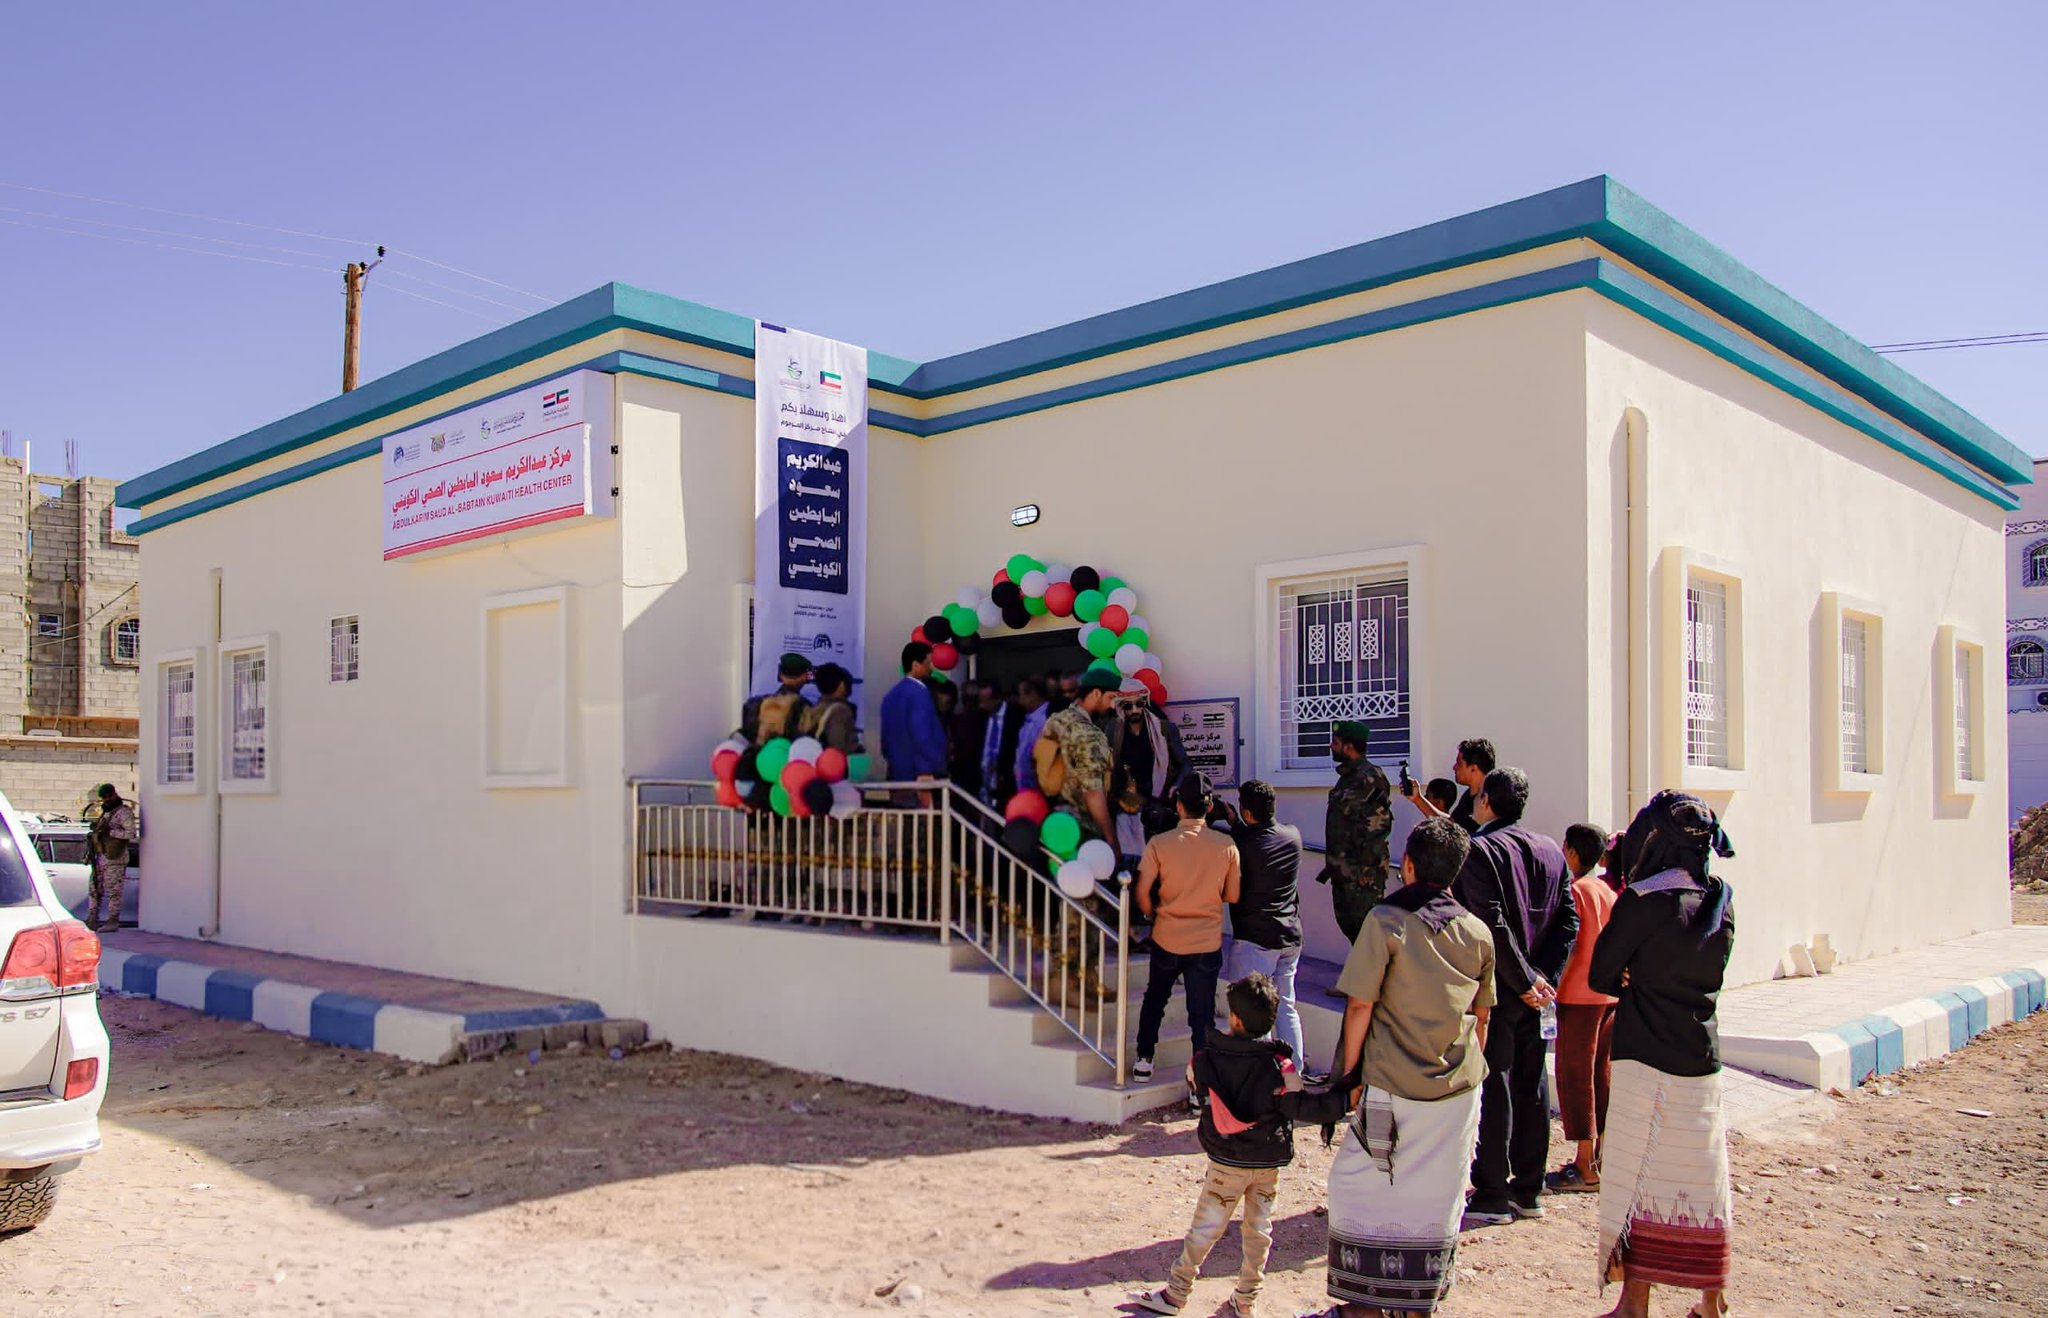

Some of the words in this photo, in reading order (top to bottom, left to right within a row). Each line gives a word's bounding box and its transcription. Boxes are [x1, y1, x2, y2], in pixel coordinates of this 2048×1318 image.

[549, 446, 572, 470] مركز
[447, 469, 479, 498] البابطين
[480, 468, 503, 488] سعود
[788, 478, 841, 500] سعود
[392, 487, 420, 517] الكويتي
[392, 511, 430, 530] ABDULKARIM
[430, 508, 447, 521] SAUD
[486, 489, 514, 505] KUWAITI
[515, 481, 542, 497] HEALTH
[543, 474, 573, 491] CENTER
[421, 479, 446, 508] الصحي
[788, 504, 841, 527] البابطين
[788, 534, 841, 553] الصحي
[787, 559, 842, 580] الكويتي
